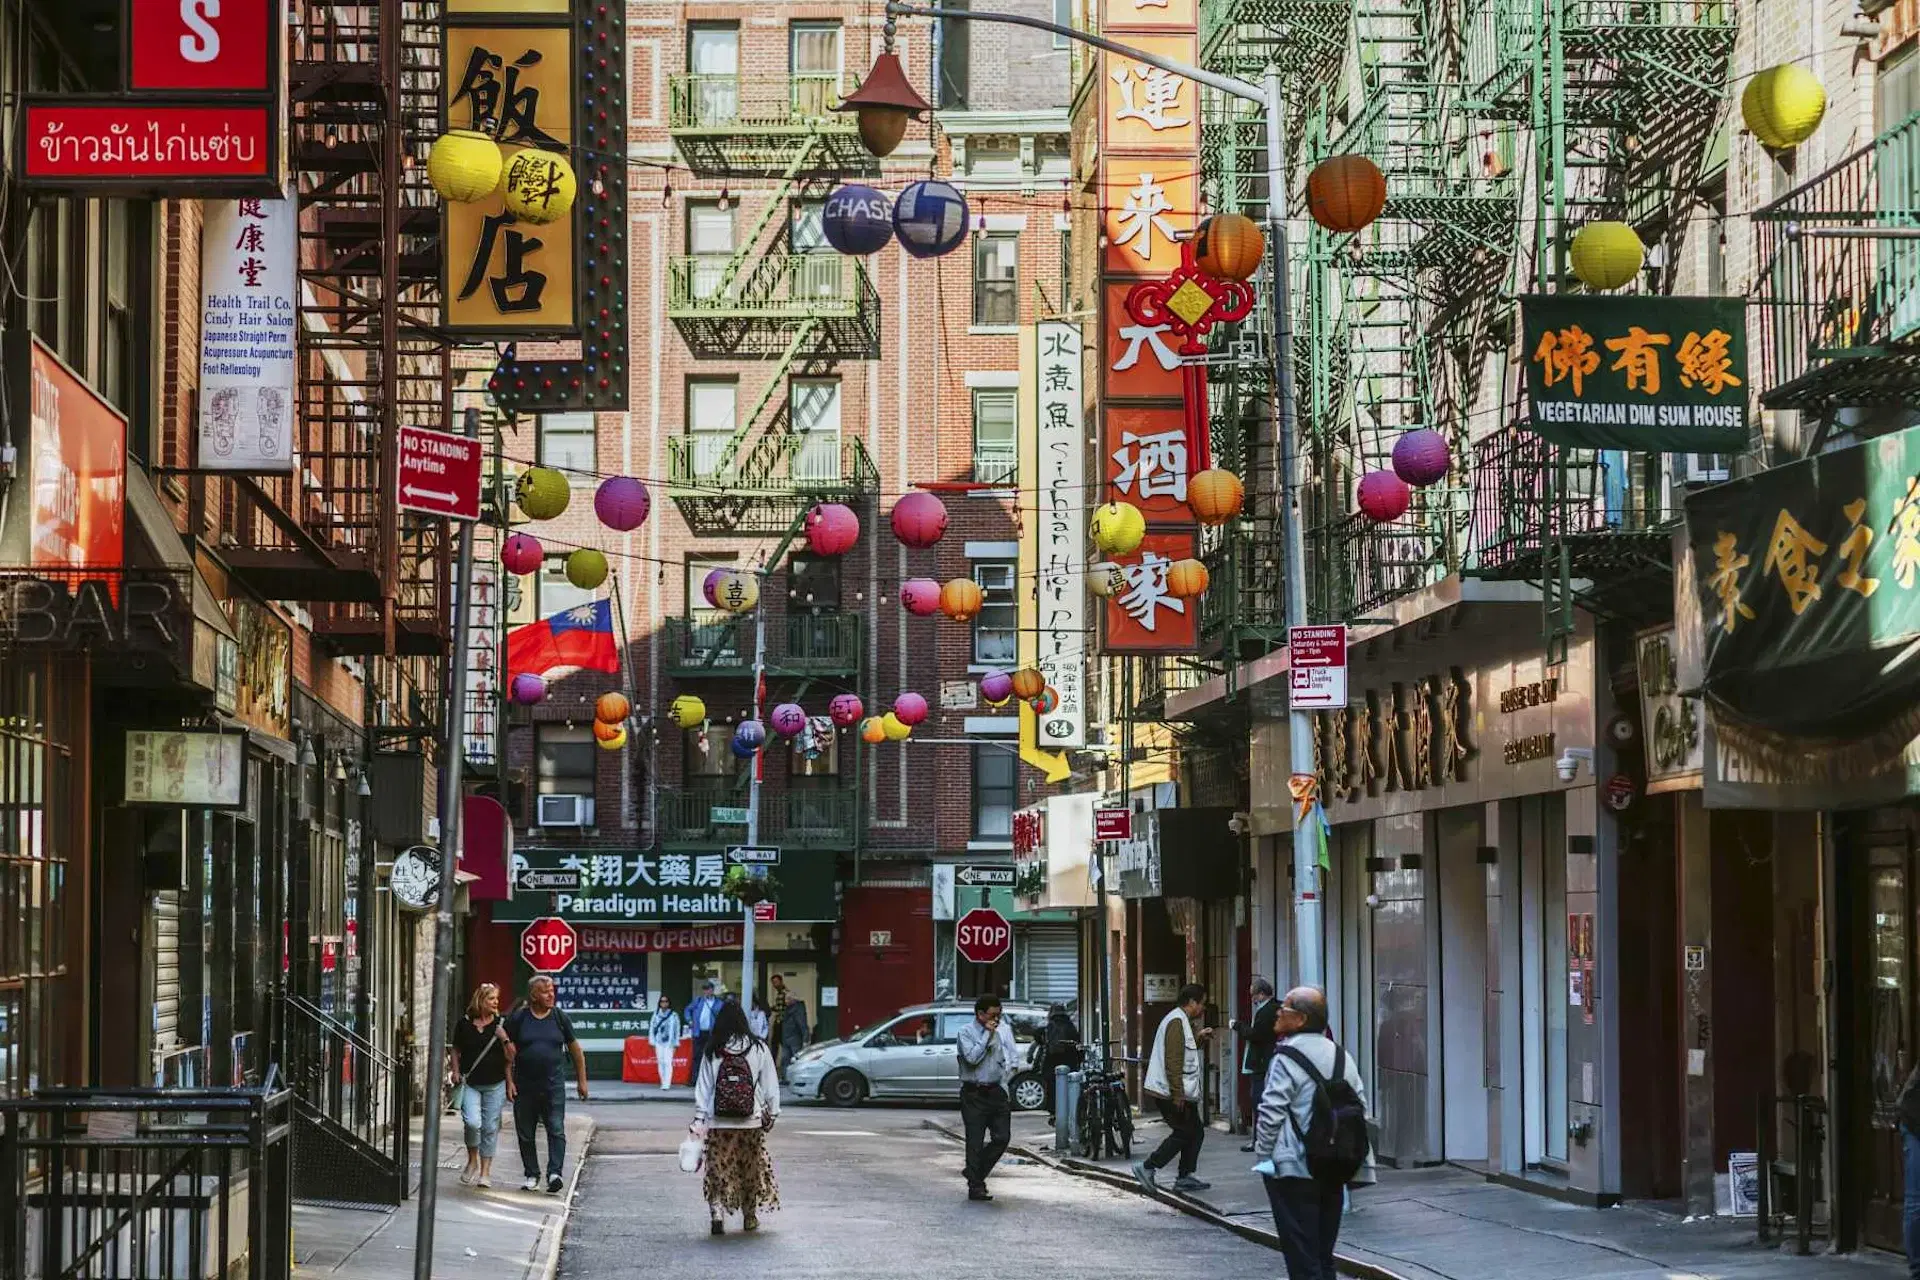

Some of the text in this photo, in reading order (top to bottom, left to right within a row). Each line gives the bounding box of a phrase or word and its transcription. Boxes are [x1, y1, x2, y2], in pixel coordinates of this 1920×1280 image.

[179, 0, 221, 63] S
[39, 121, 256, 163] ข้าวมันไก่แซ่บ
[825, 198, 893, 222] CHASE
[208, 295, 291, 310] Health Trail Co.
[204, 311, 293, 328] Cindy Hair Salon
[1111, 0, 1191, 632] 運來大酒家
[204, 330, 287, 344] Japanese Straight Perm
[204, 346, 293, 360] Acupressure Acupuncture
[203, 363, 261, 378] Foot Reflexology
[1043, 331, 1076, 429] 水煮魚
[1536, 401, 1743, 427] VEGETARIAN DIM SUM HOUSE
[403, 435, 469, 461] NO STANDING
[403, 453, 445, 474] Anytime
[726, 580, 747, 607] 喜
[12, 580, 173, 642] BAR
[1292, 630, 1336, 639] NO STANDING
[756, 851, 773, 859] WAY
[526, 874, 573, 884] ONE WAY
[963, 871, 1010, 880] ONE WAY
[557, 893, 657, 918] Paradigm
[663, 893, 731, 913] Health
[525, 934, 573, 956] STOP
[582, 925, 735, 949] GRAND OPENING
[959, 925, 1007, 946] STOP
